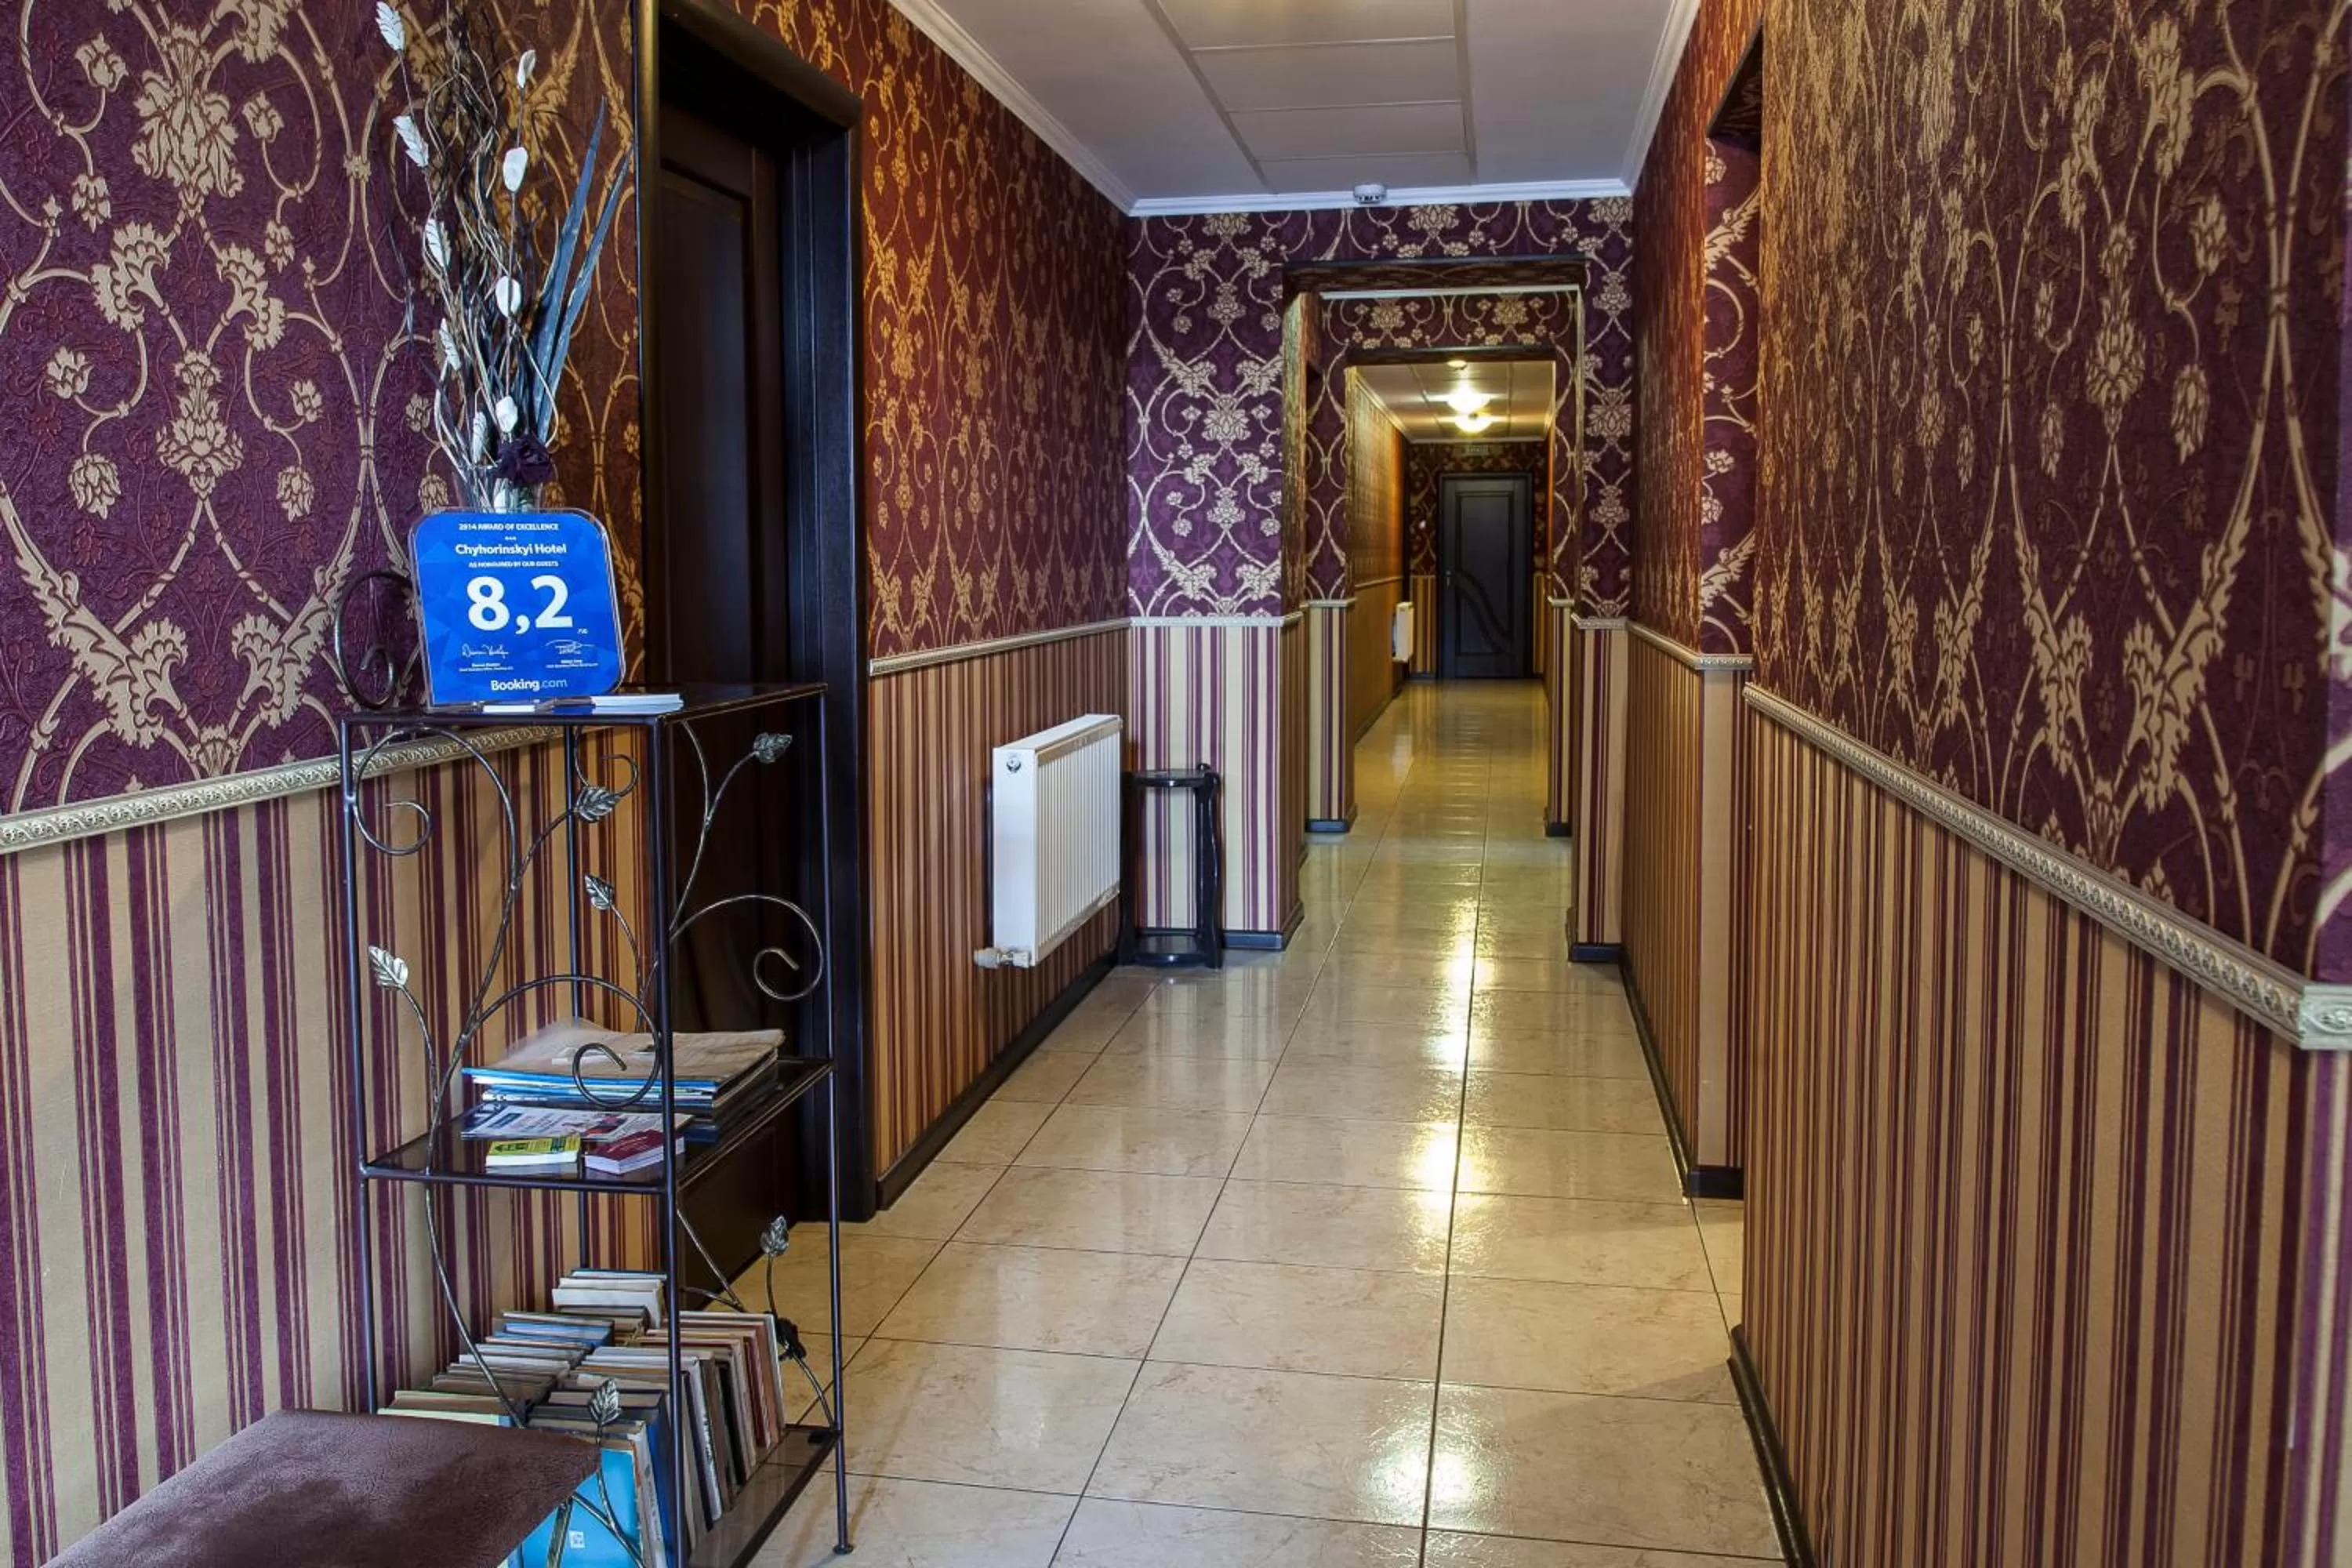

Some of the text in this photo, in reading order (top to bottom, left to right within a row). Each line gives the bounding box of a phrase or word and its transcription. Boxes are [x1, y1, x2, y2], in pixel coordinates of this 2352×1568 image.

[456, 543, 567, 557] Chyhorinskyi Hotel
[466, 575, 572, 634] 8,2
[490, 678, 568, 691] Booking.com
